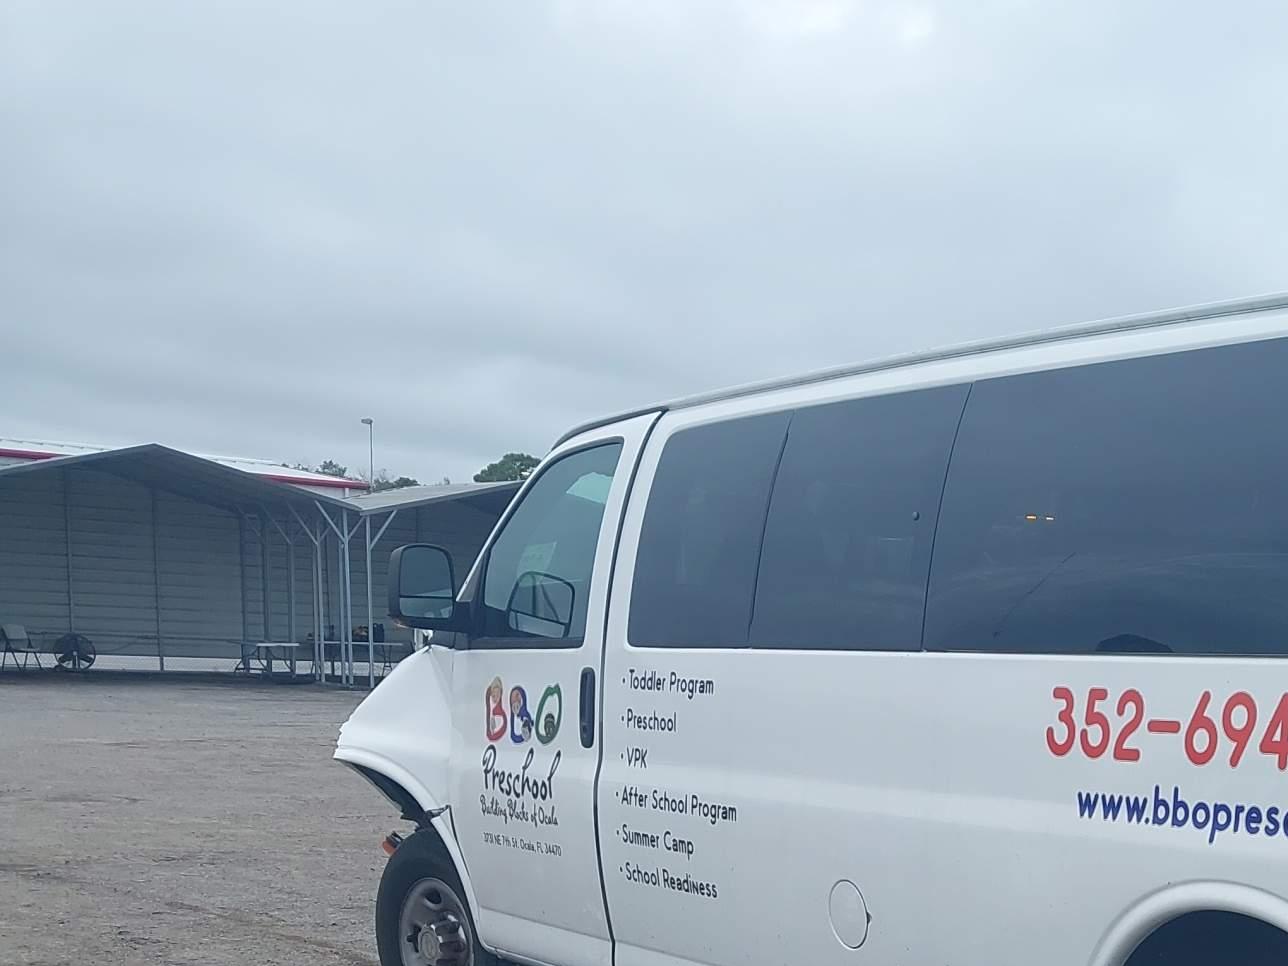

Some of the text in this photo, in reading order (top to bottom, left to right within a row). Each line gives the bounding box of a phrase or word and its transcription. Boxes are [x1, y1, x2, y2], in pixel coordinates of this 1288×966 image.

[628, 669, 714, 699] Toddler Program
[626, 708, 677, 732] Preschool
[627, 747, 648, 768] VPK
[482, 745, 561, 801] Preschool
[538, 805, 559, 825] Ocala
[621, 786, 737, 824] After School Program
[622, 824, 694, 860] Summer Camp
[625, 863, 660, 887] School
